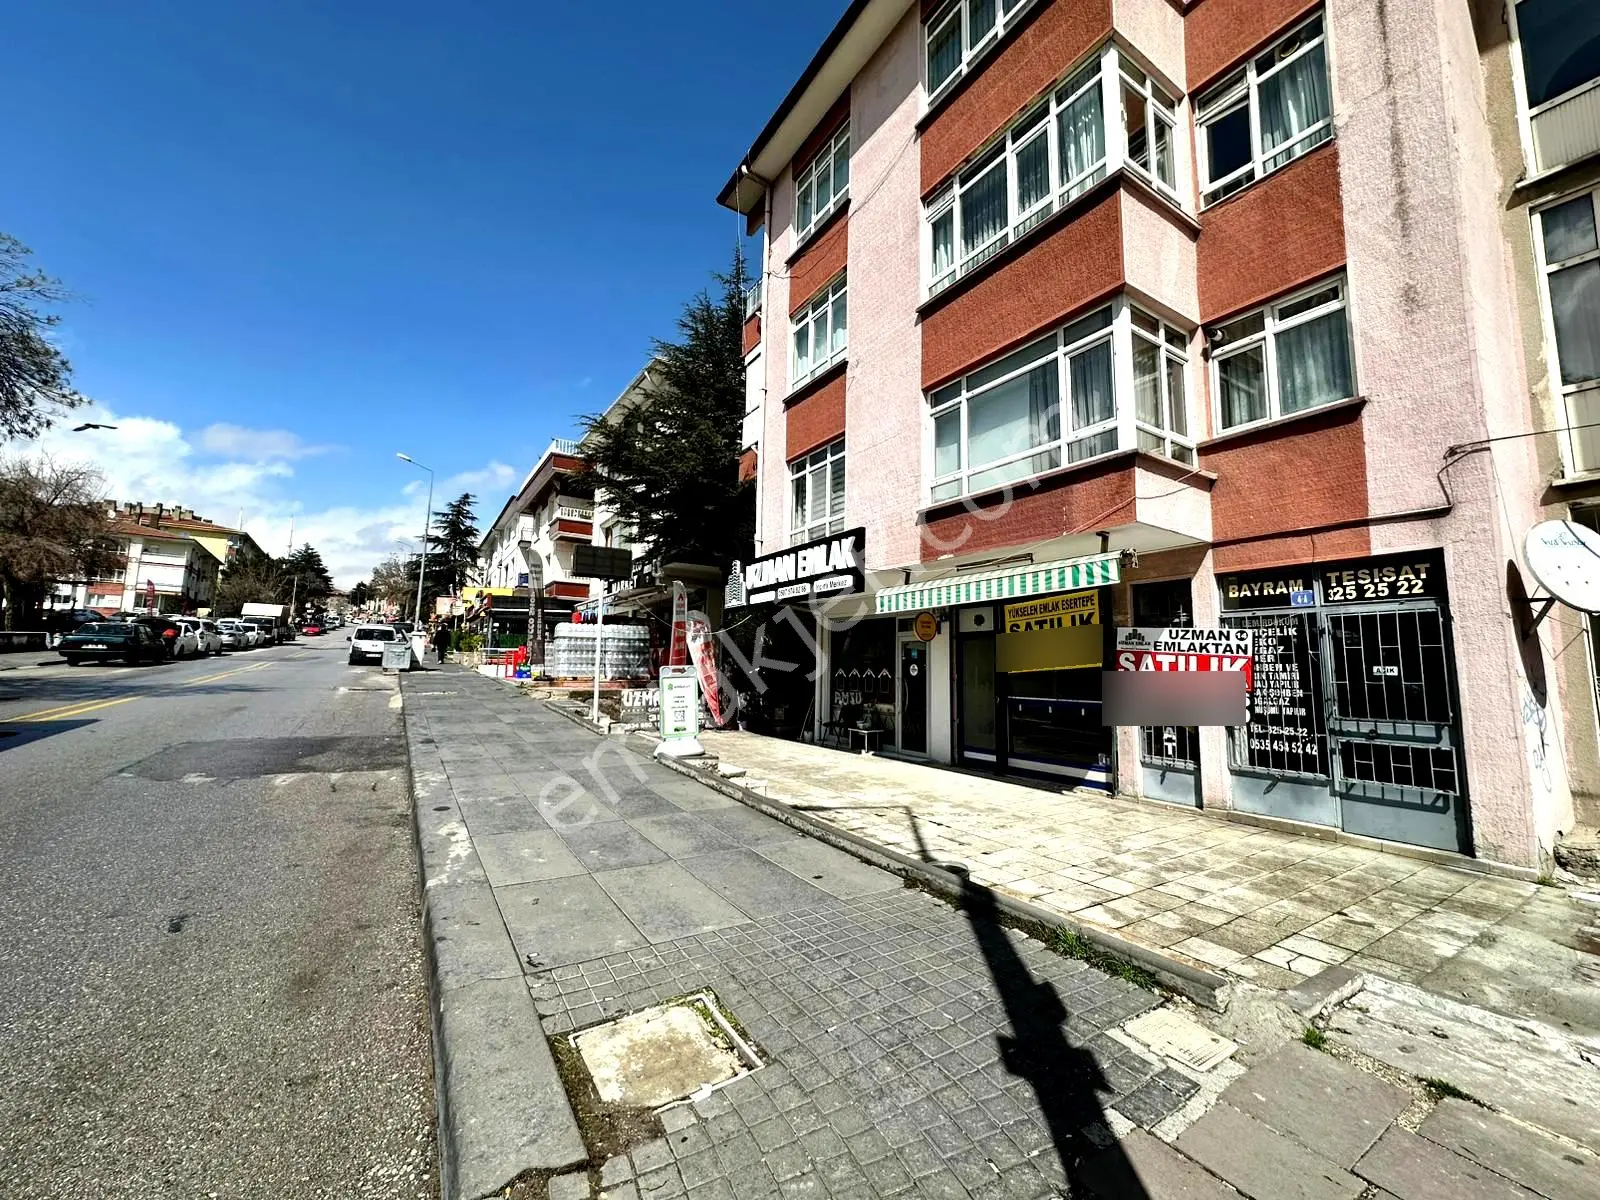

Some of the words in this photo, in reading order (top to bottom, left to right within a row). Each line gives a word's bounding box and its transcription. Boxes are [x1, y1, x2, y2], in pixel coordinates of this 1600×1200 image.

[1228, 578, 1304, 598] BAYRAM
[1364, 582, 1390, 598] 25
[1396, 579, 1425, 595] 22
[1008, 604, 1038, 619] YÜKSELEN
[1039, 600, 1060, 614] EMLAK
[1061, 594, 1095, 610] ESERTEPE
[1168, 629, 1231, 641] UZMAN
[1153, 640, 1248, 655] EMLAKTAN
[1249, 738, 1271, 751] 0535
[1291, 741, 1304, 755] 52
